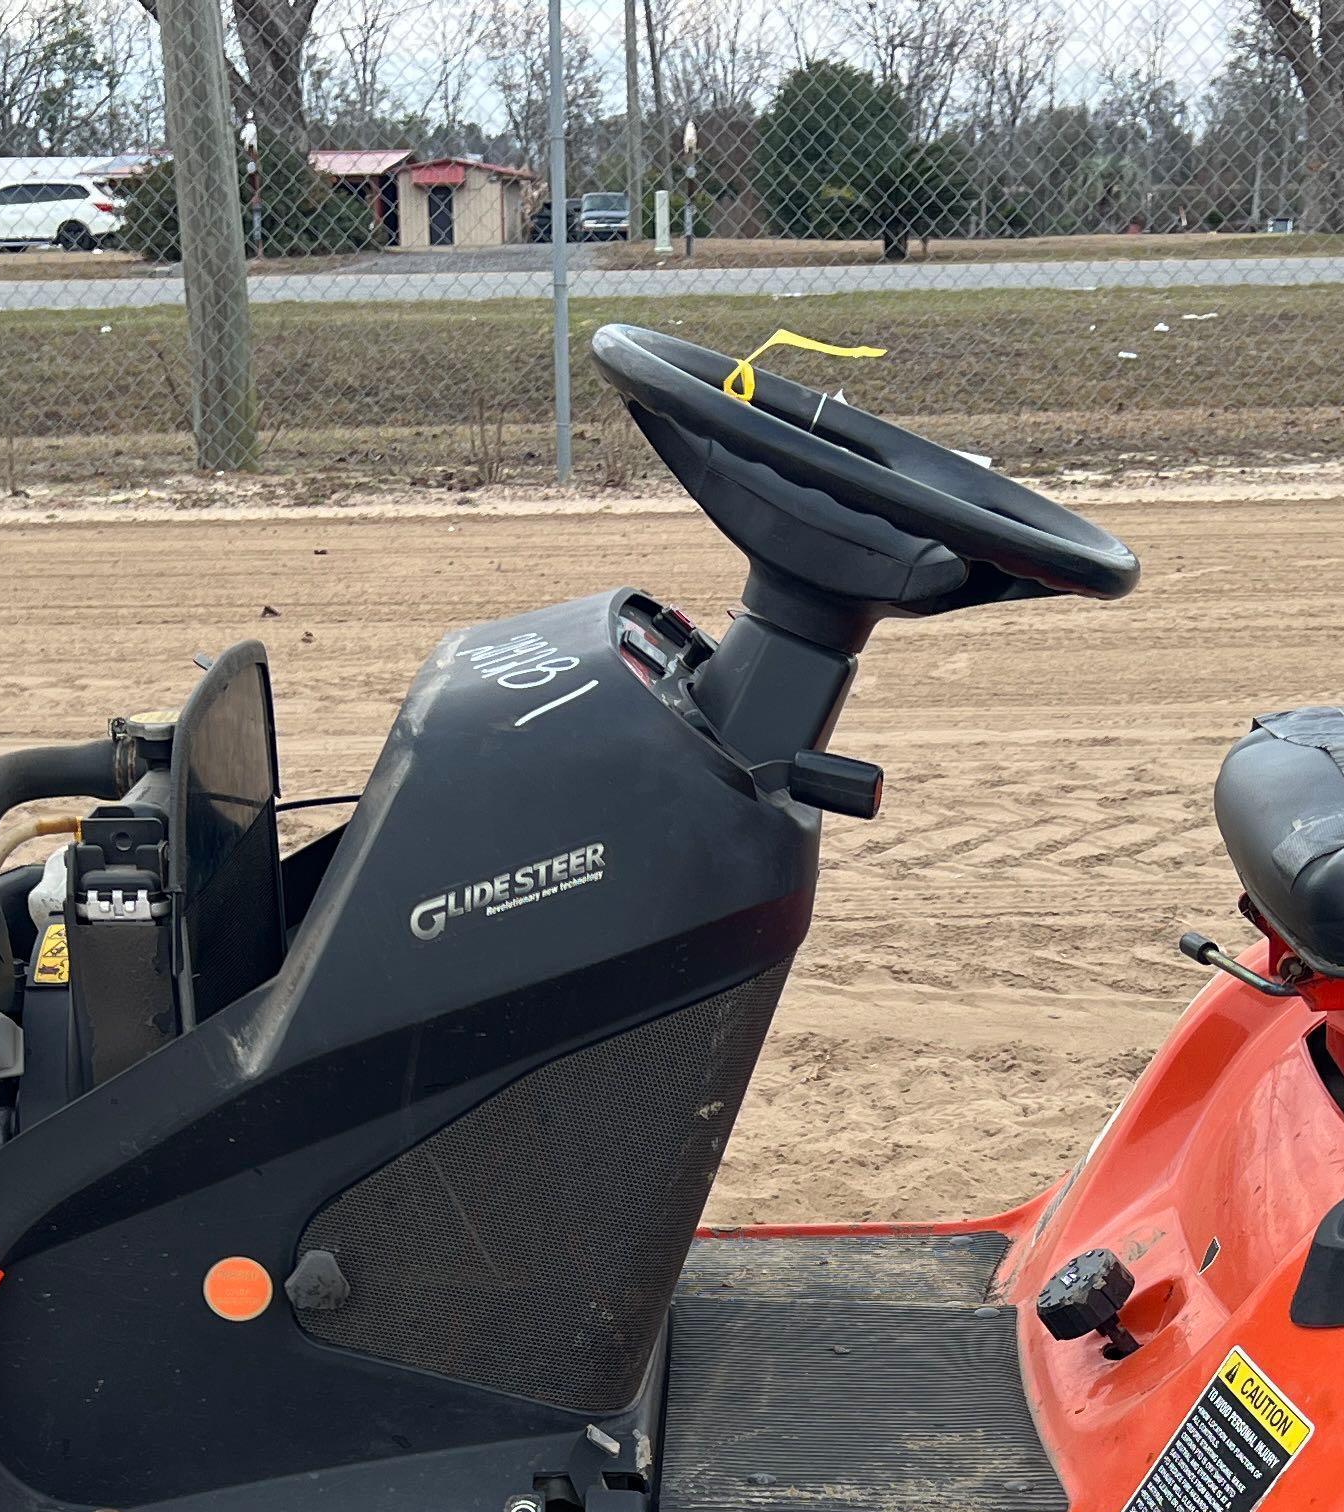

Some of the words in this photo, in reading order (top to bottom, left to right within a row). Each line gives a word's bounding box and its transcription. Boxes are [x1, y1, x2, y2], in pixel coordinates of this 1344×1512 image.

[485, 891, 540, 917] Revolutionary
[541, 884, 559, 898] new
[559, 870, 604, 892] technology
[1206, 1386, 1218, 1402] TO
[1212, 1394, 1233, 1418] AVOID
[1227, 1409, 1259, 1448] PERSONAL
[1253, 1439, 1280, 1470] INJURY
[1238, 1375, 1294, 1438] CAUTION
[1207, 1416, 1228, 1442] LOCATION
[1224, 1437, 1236, 1451] AND
[1232, 1446, 1256, 1474] FUNCTION
[1252, 1468, 1262, 1481] OF
